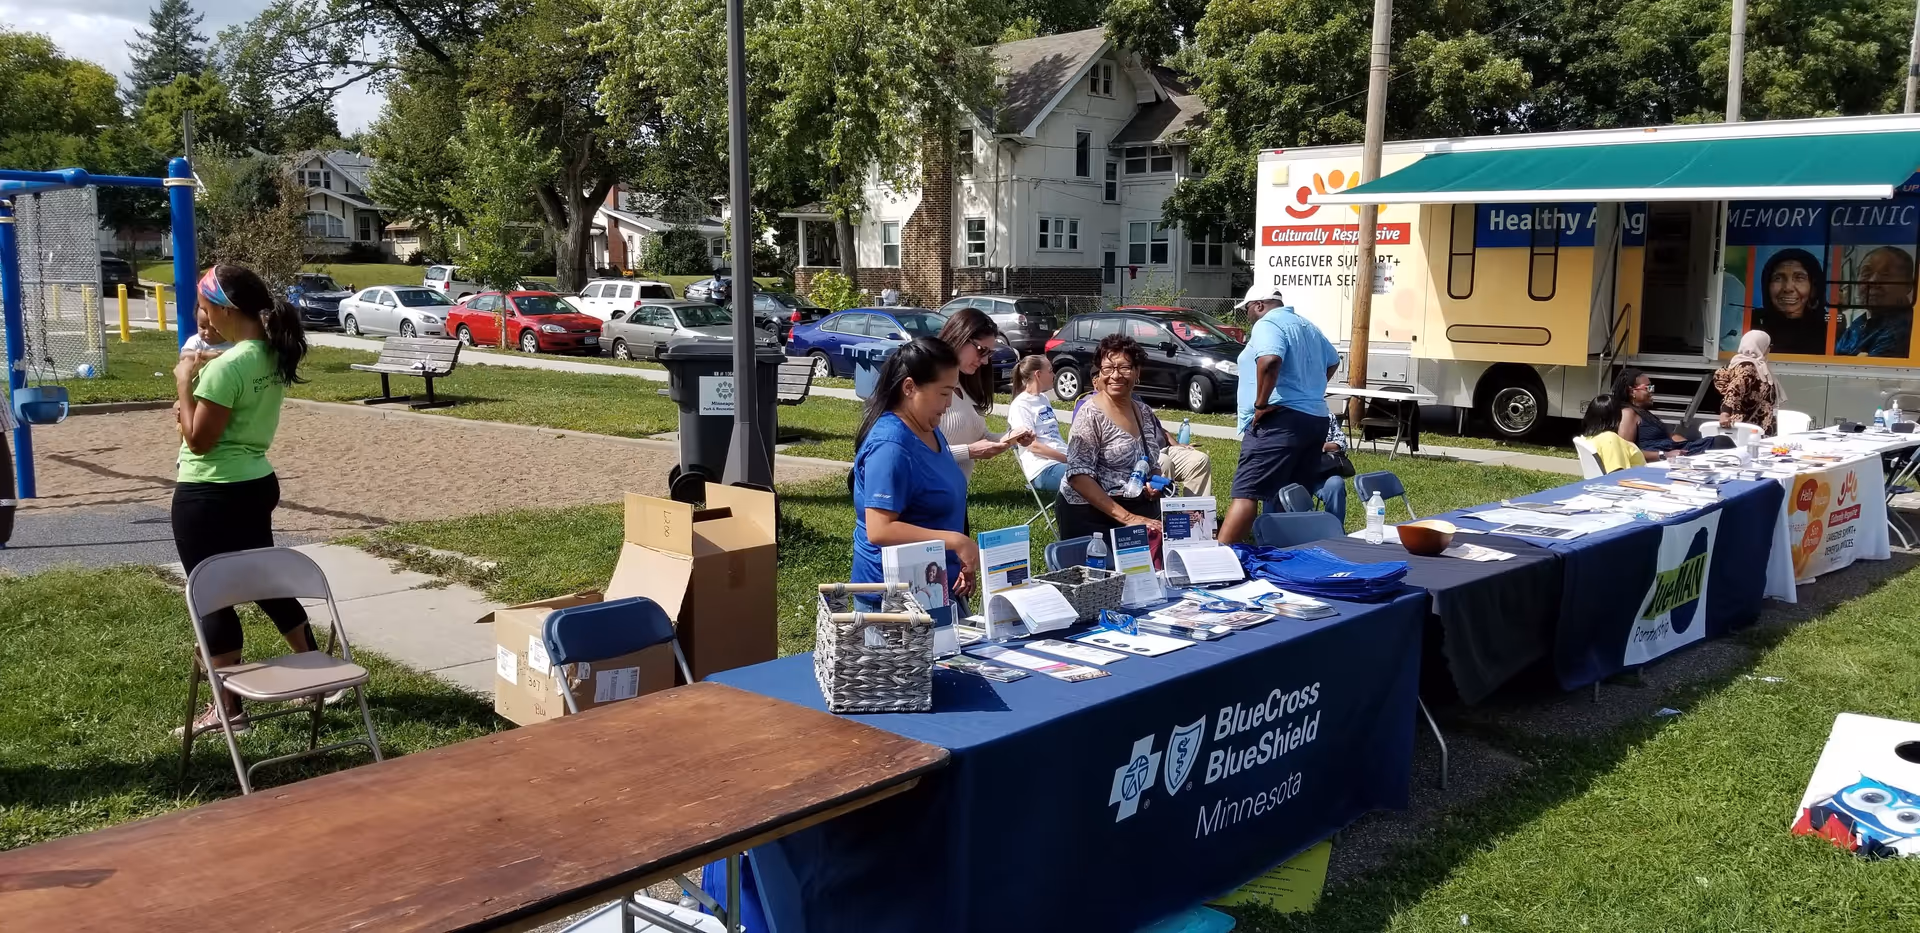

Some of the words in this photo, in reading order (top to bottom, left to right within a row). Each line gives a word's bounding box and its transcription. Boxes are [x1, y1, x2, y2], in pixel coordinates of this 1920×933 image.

[1489, 207, 1581, 235] Healthy
[1727, 207, 1822, 228] MEMORY
[1831, 205, 1915, 227] CLINIC
[1271, 228, 1329, 244] Culturally
[1332, 227, 1400, 243] Respsive
[1268, 255, 1333, 267] CAREGIVER
[1273, 274, 1332, 287] DEMENTIA
[1213, 681, 1321, 742] BlueCross
[1204, 710, 1322, 785] BlueShield
[1195, 771, 1302, 839] Minnesota
